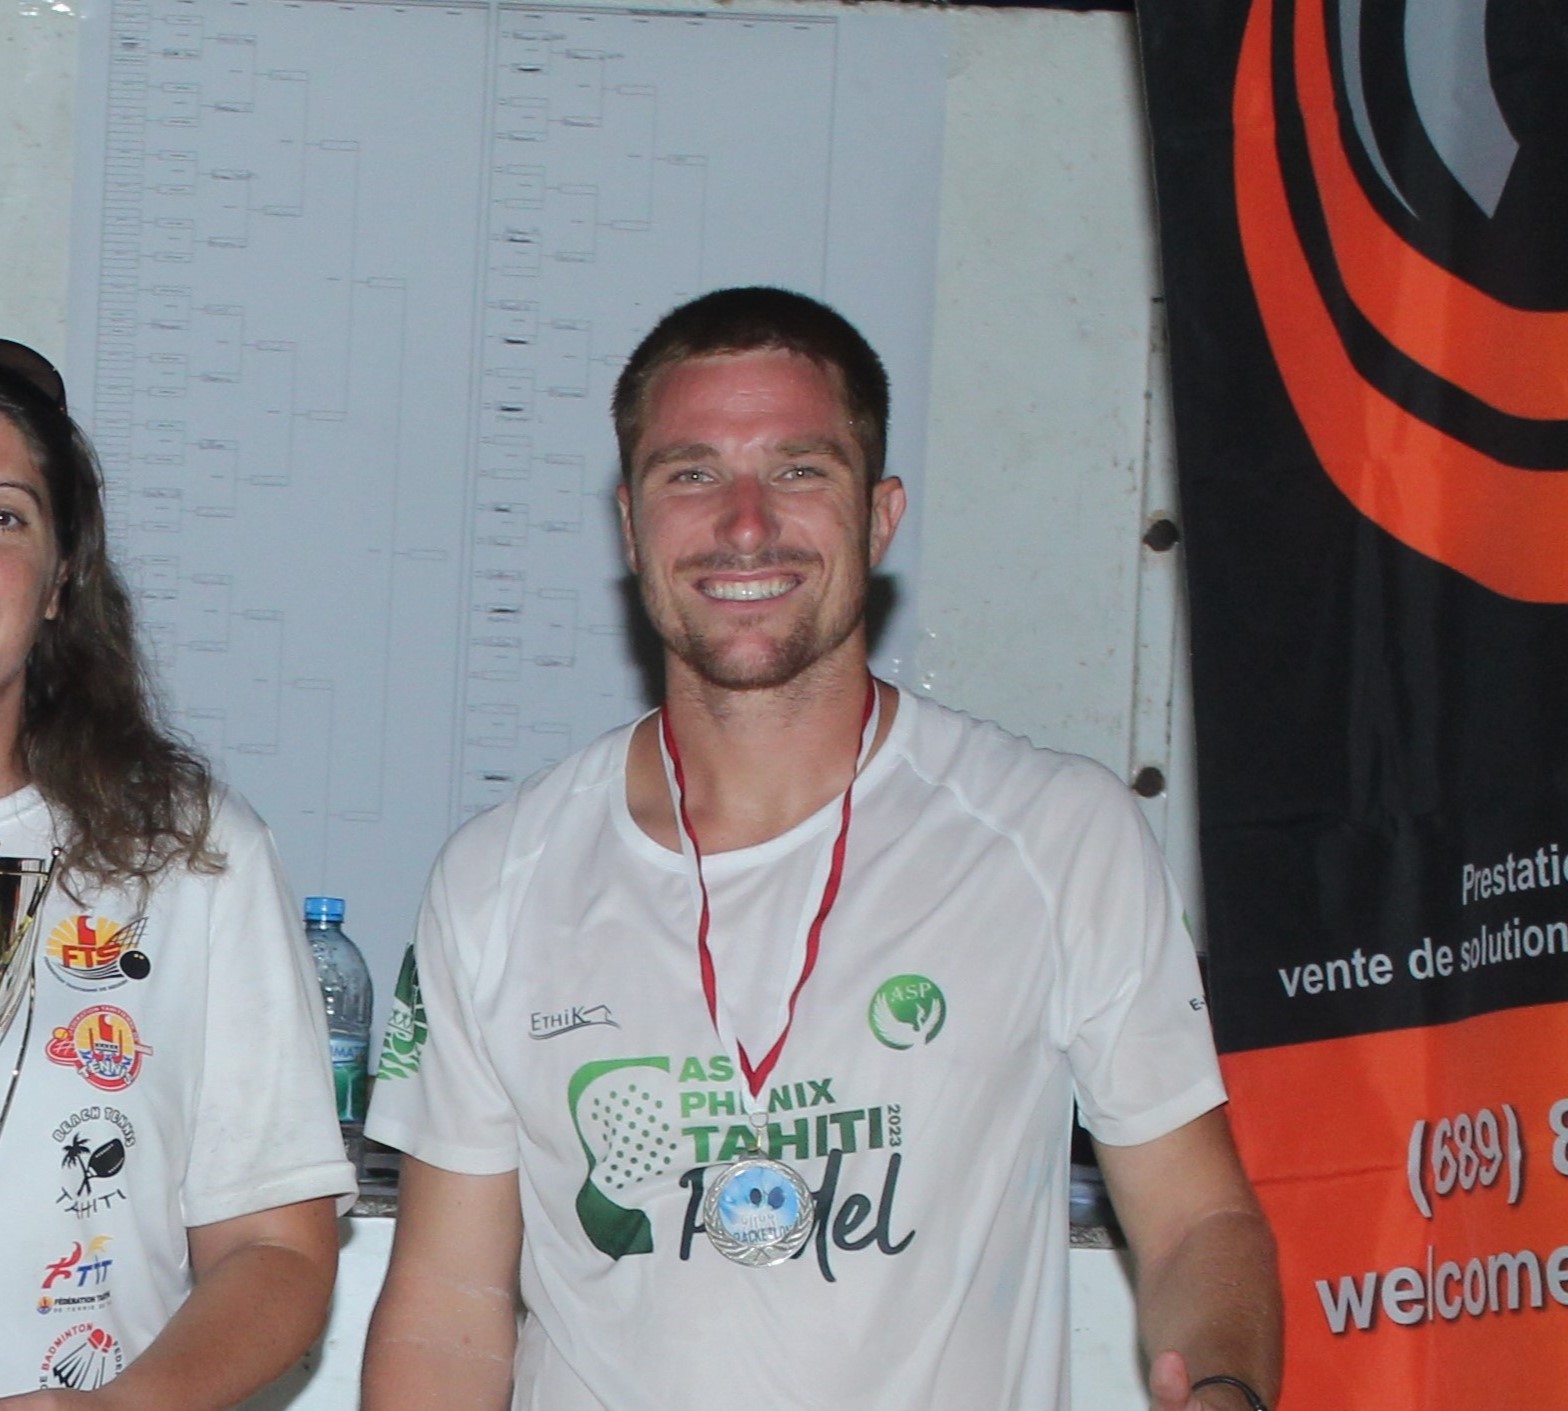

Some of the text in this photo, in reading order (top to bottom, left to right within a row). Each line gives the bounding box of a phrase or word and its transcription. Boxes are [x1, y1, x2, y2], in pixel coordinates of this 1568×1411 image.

[1462, 844, 1568, 906] Prestati
[62, 943, 121, 969] FTS
[1278, 949, 1393, 997] vente
[1408, 937, 1453, 980] de
[891, 982, 932, 1002] ASP
[78, 1058, 133, 1085] TENNIS
[679, 1056, 734, 1082] AS
[680, 1078, 836, 1118] PHNIX
[52, 1106, 136, 1148] BEACH TENNIS
[682, 1106, 883, 1163] TAHITI
[888, 1104, 903, 1148] 2023
[1407, 1104, 1522, 1218] (689)
[56, 1187, 127, 1220] TAHITI
[679, 1149, 916, 1283] Pdel
[41, 1322, 94, 1371] BADMINTON
